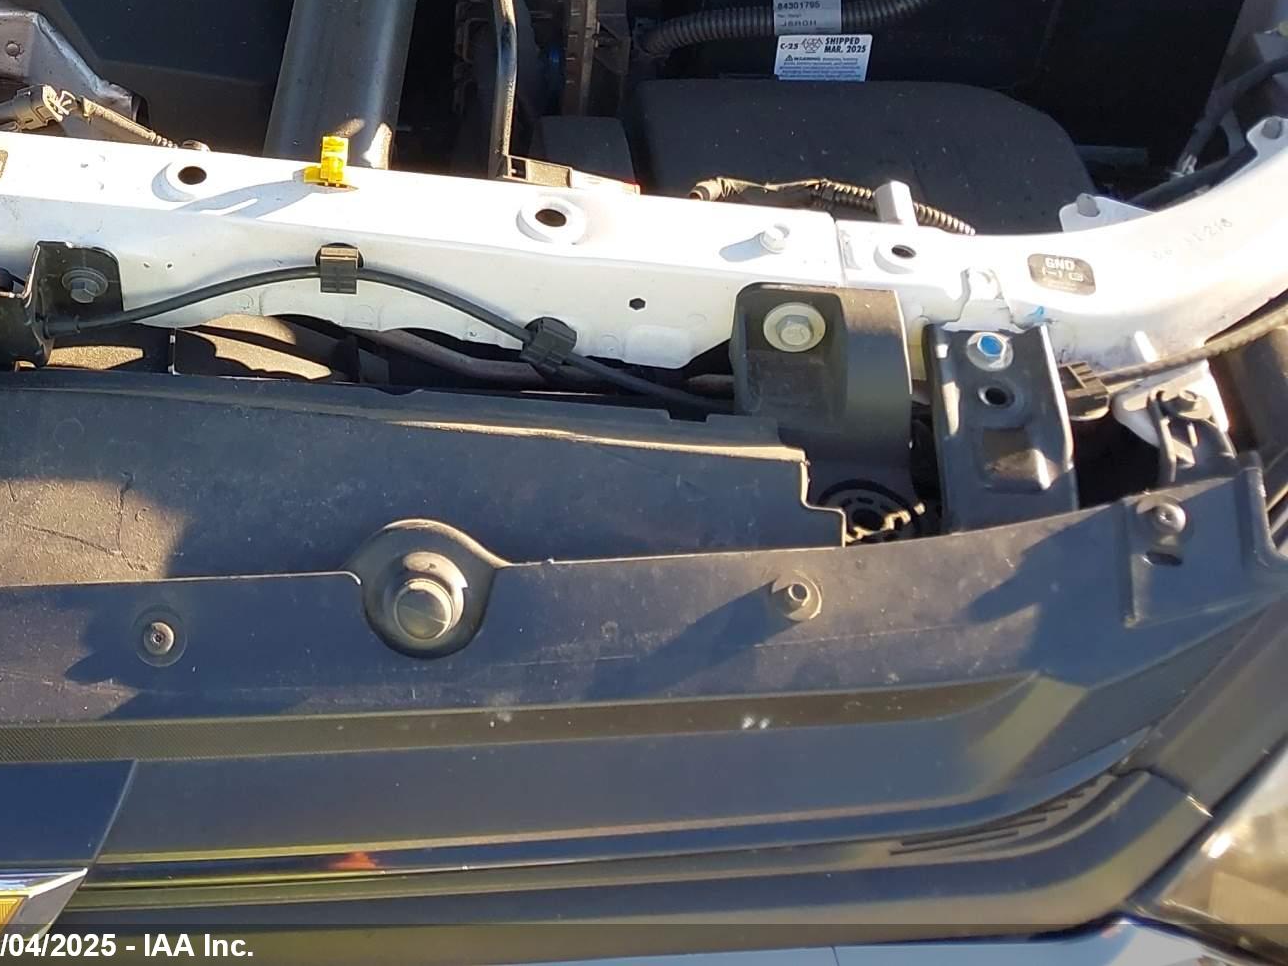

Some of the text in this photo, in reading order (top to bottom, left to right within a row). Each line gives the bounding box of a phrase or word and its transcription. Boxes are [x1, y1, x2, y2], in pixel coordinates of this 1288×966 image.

[825, 37, 861, 45] SHIPPED
[779, 42, 799, 50] C-25
[823, 45, 867, 53] MAR. 2025
[1044, 257, 1075, 271] GND
